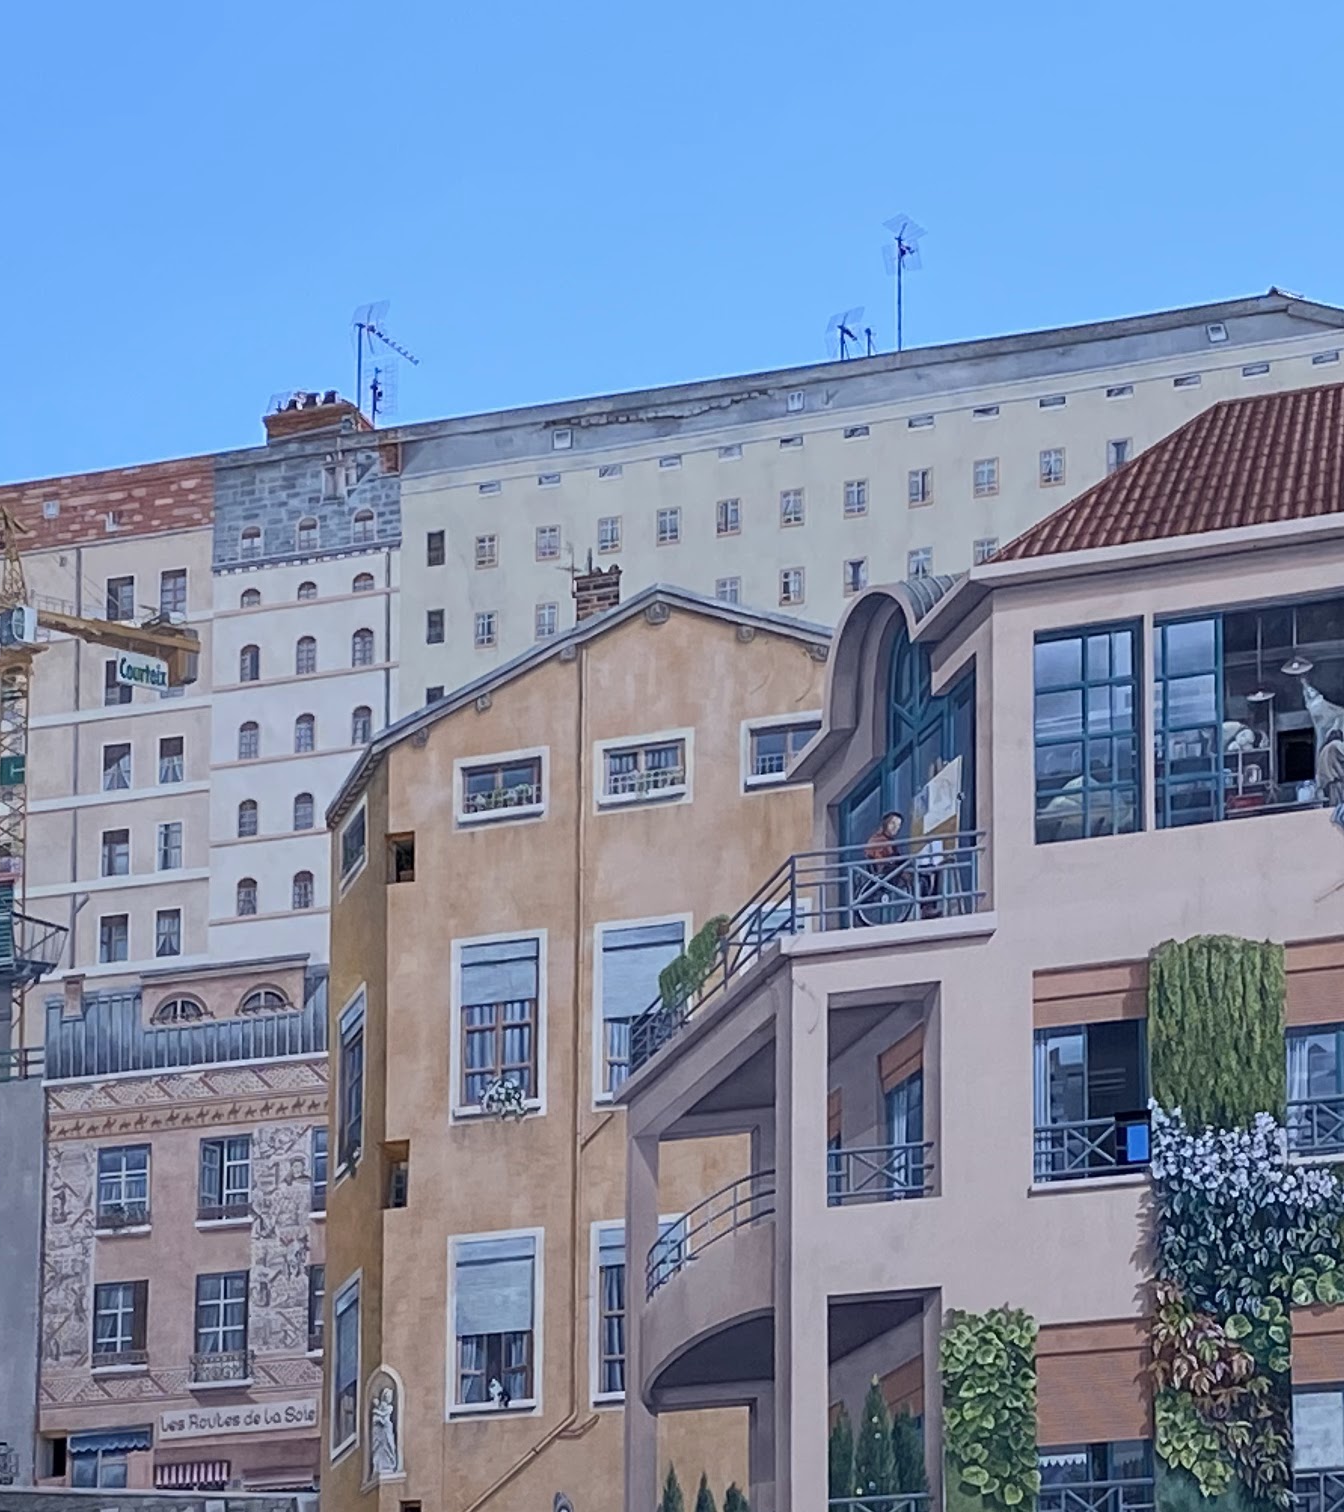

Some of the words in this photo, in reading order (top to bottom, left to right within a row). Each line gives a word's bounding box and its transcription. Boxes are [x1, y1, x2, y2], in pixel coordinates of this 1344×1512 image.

[160, 1414, 185, 1433] Les
[188, 1412, 241, 1431] Routes
[243, 1409, 261, 1426] de
[284, 1404, 316, 1423] Soie
